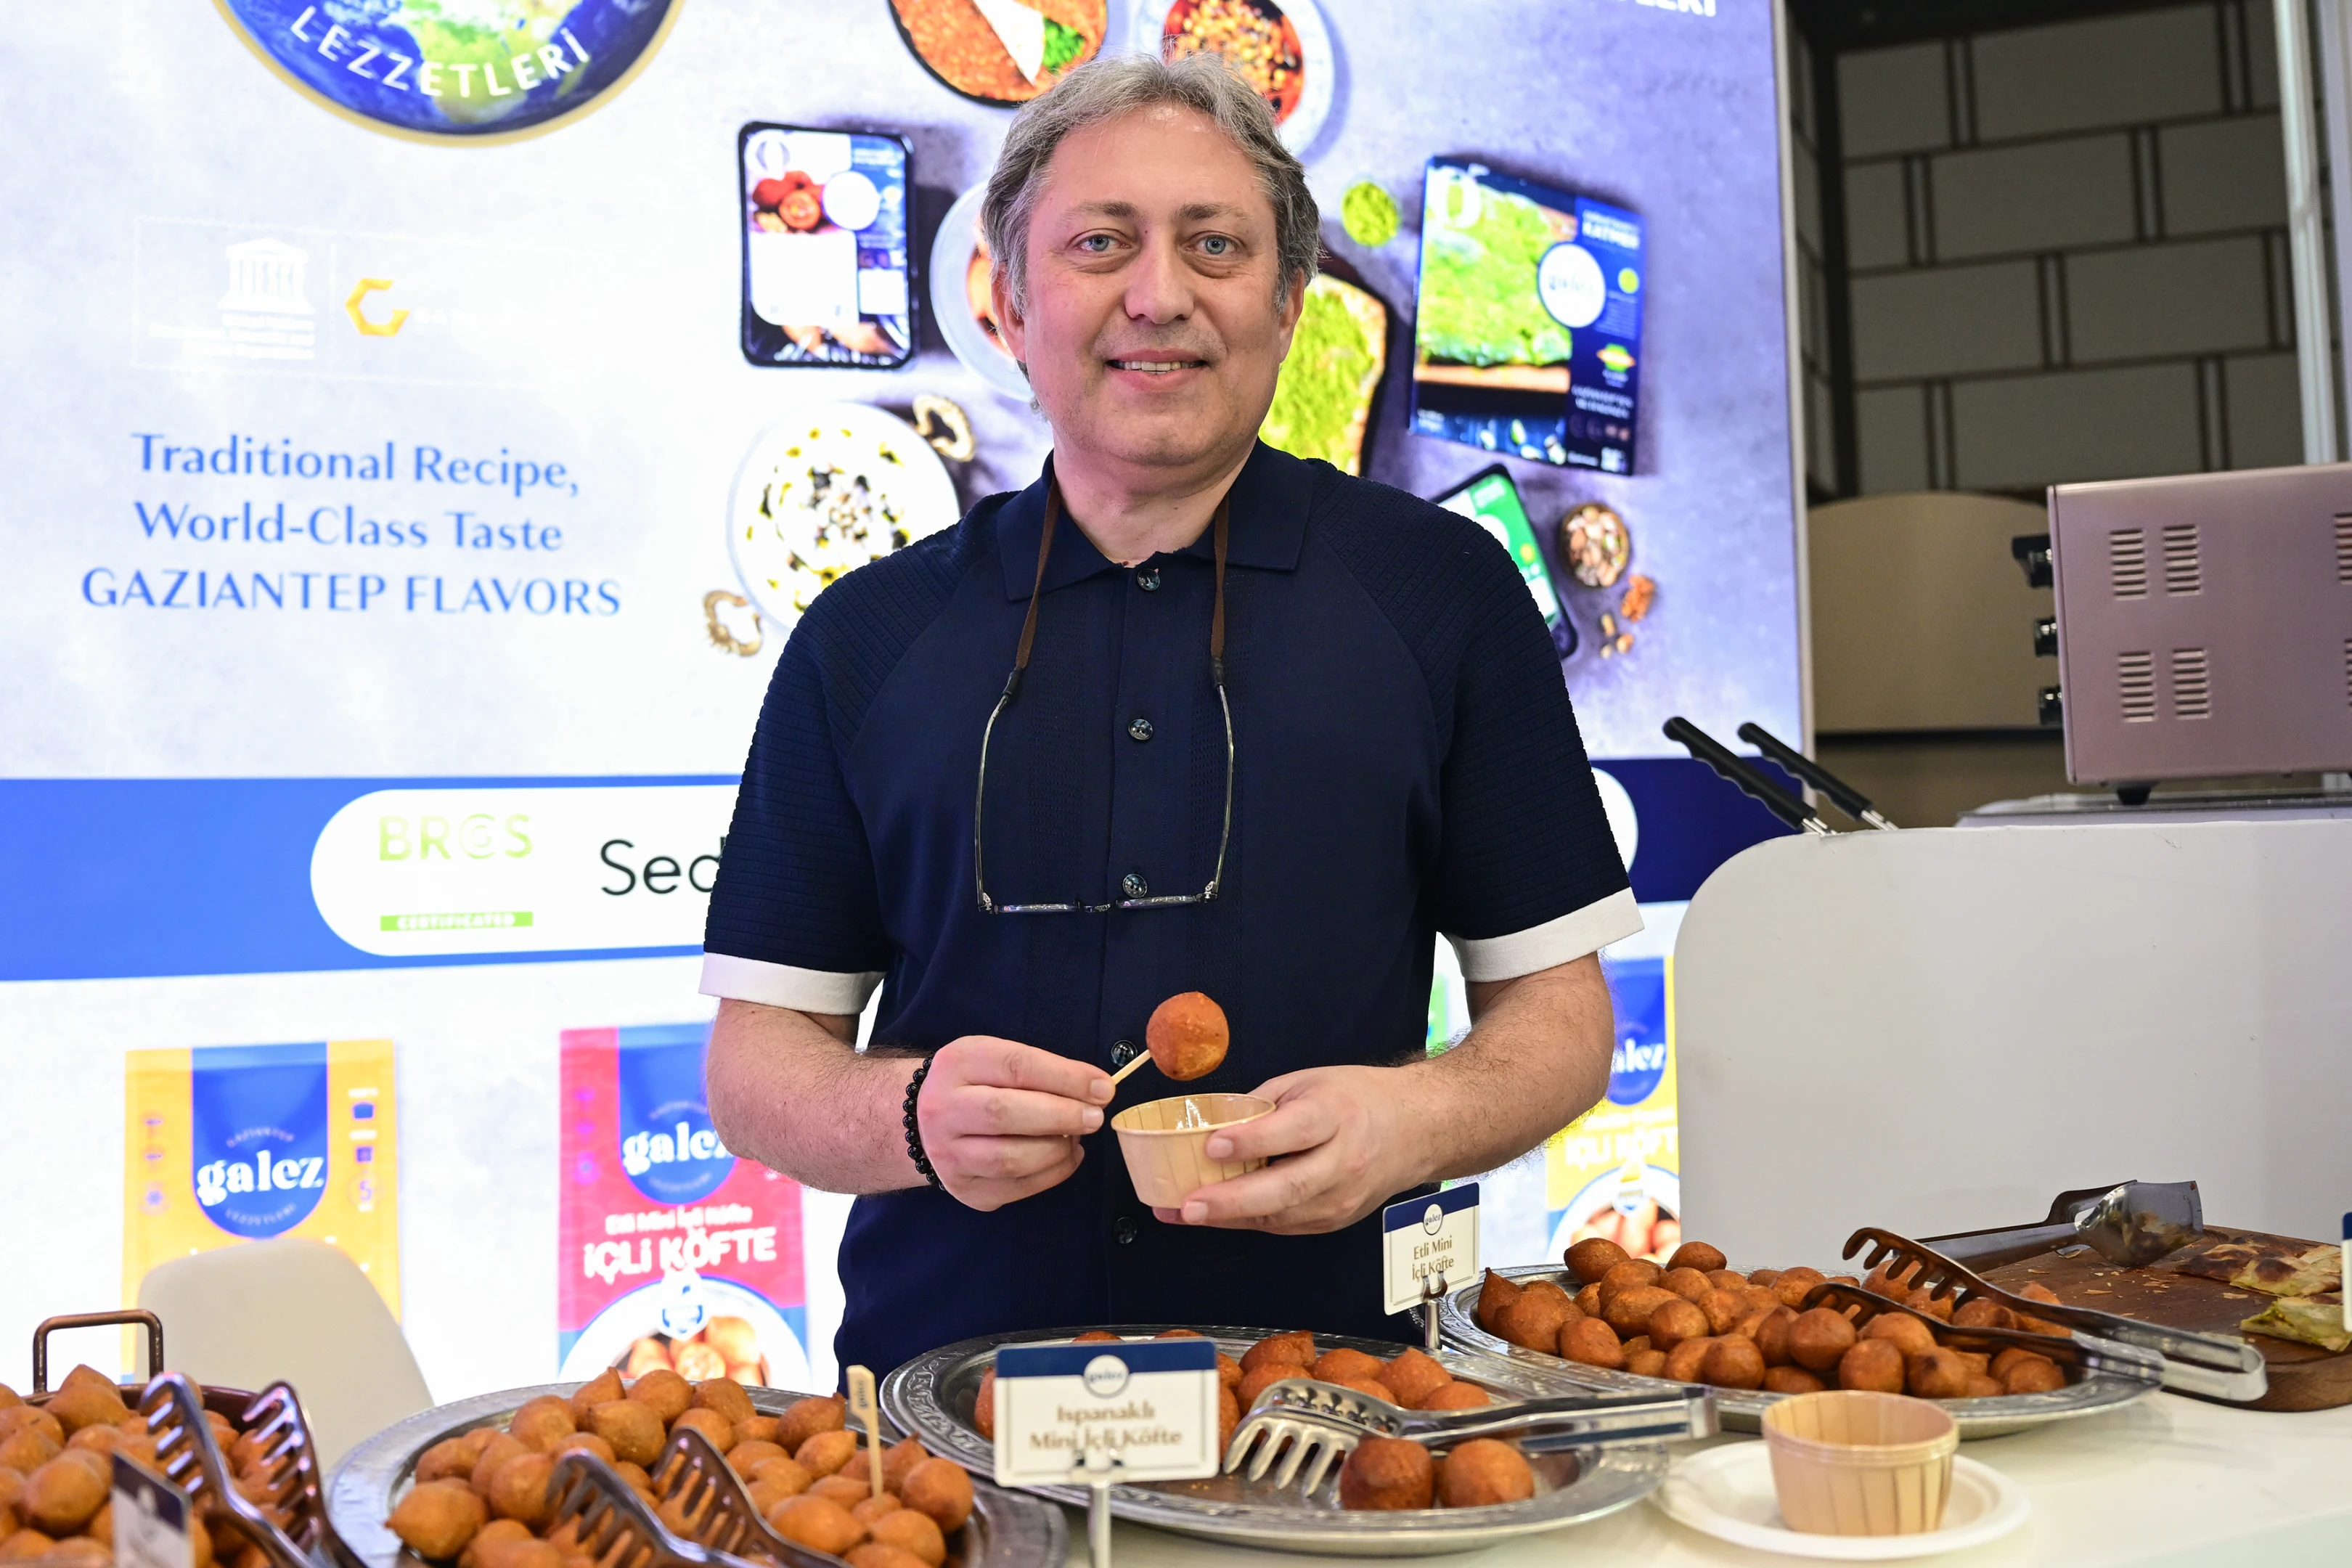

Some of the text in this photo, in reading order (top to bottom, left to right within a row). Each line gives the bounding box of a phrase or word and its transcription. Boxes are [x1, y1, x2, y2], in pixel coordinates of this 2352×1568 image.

[289, 6, 591, 98] LEZZETLERİ
[131, 432, 579, 499] Traditional Recipe,
[134, 500, 563, 552] World-Class Taste
[82, 566, 621, 617] GAZIANTEP FLAVORS
[397, 912, 515, 931] CERTIFICATED
[197, 1149, 324, 1207] galez
[659, 1226, 777, 1270] KÖFTE
[1413, 1235, 1453, 1259] Etli Mini
[1429, 1256, 1454, 1274] Köfte
[1056, 1400, 1156, 1426] Ispanaklı
[1029, 1430, 1078, 1450] Mini
